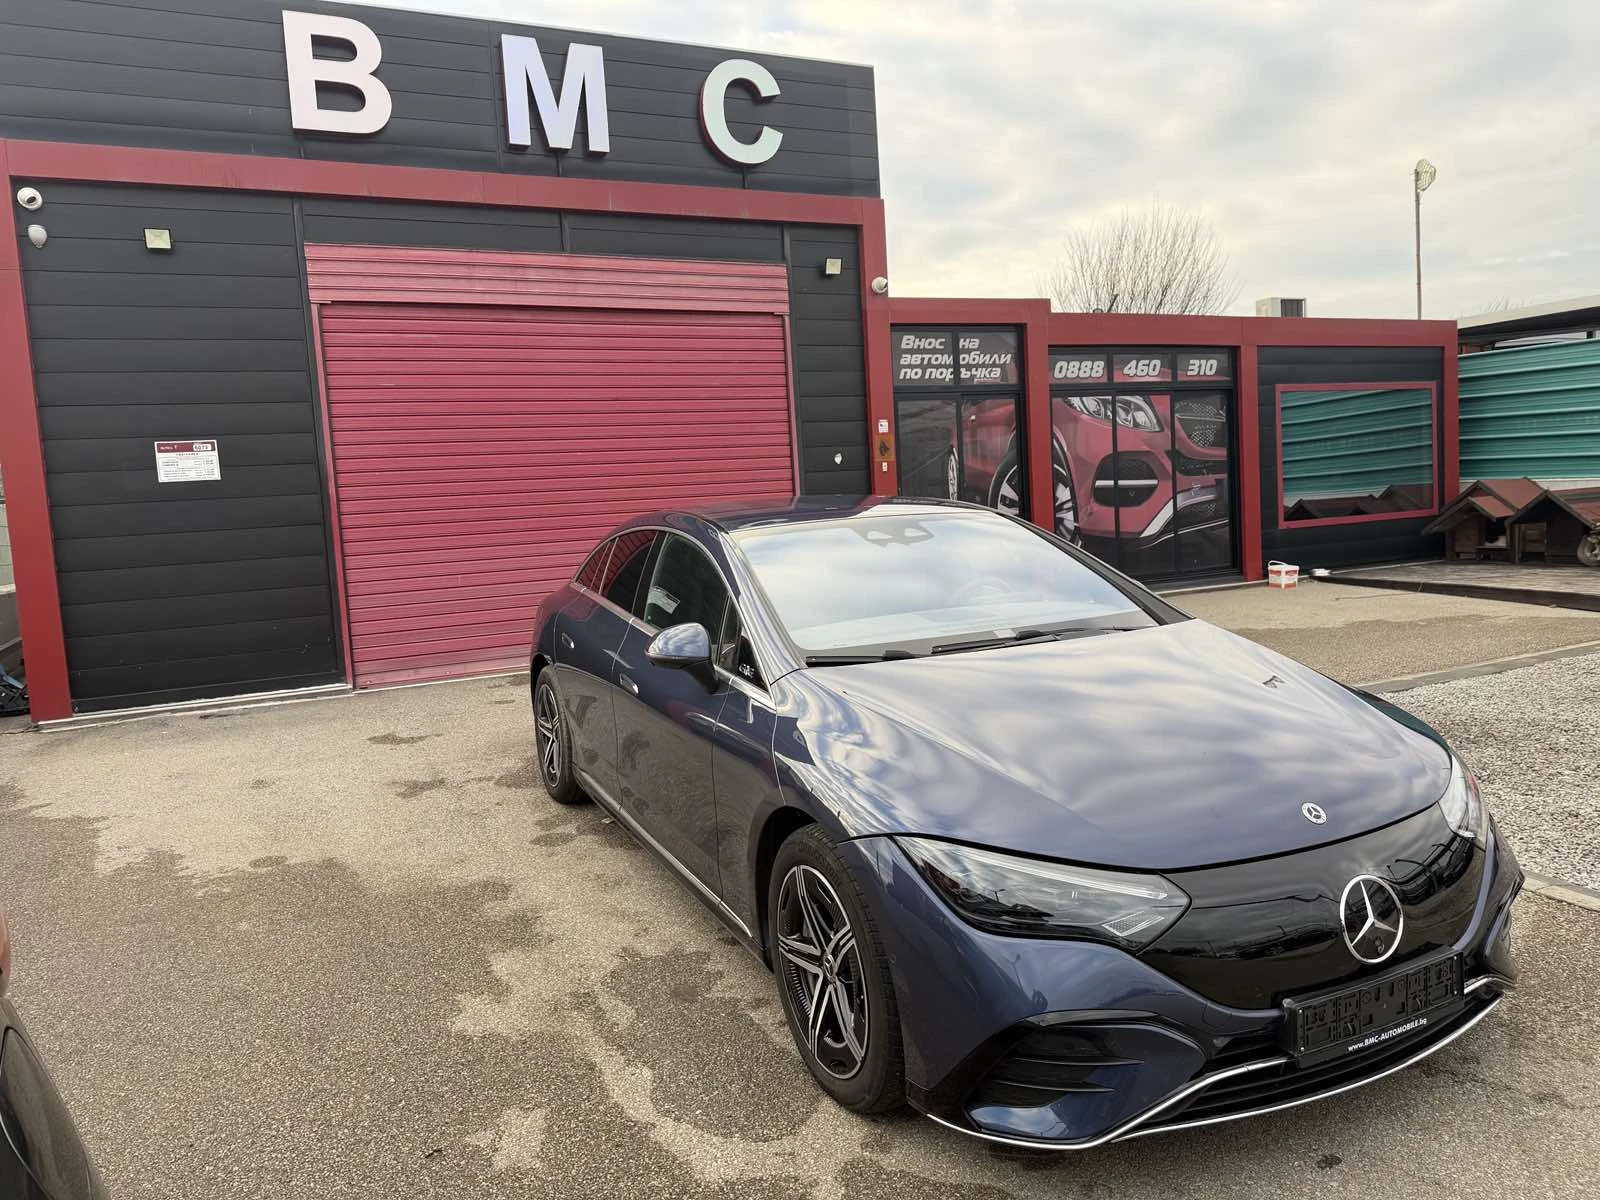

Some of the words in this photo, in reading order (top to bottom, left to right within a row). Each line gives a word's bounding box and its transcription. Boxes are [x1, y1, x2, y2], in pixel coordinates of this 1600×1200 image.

[901, 335, 946, 349] Внос
[959, 338, 980, 349] на
[899, 351, 1012, 366] автомобили
[899, 368, 923, 380] по
[924, 367, 1001, 382] поръчка
[1053, 360, 1105, 379] 0888
[1122, 359, 1162, 377] 460
[1186, 359, 1218, 376] 310
[1347, 1017, 1427, 1051] www.BMC-AUTOMOBILE.bg
